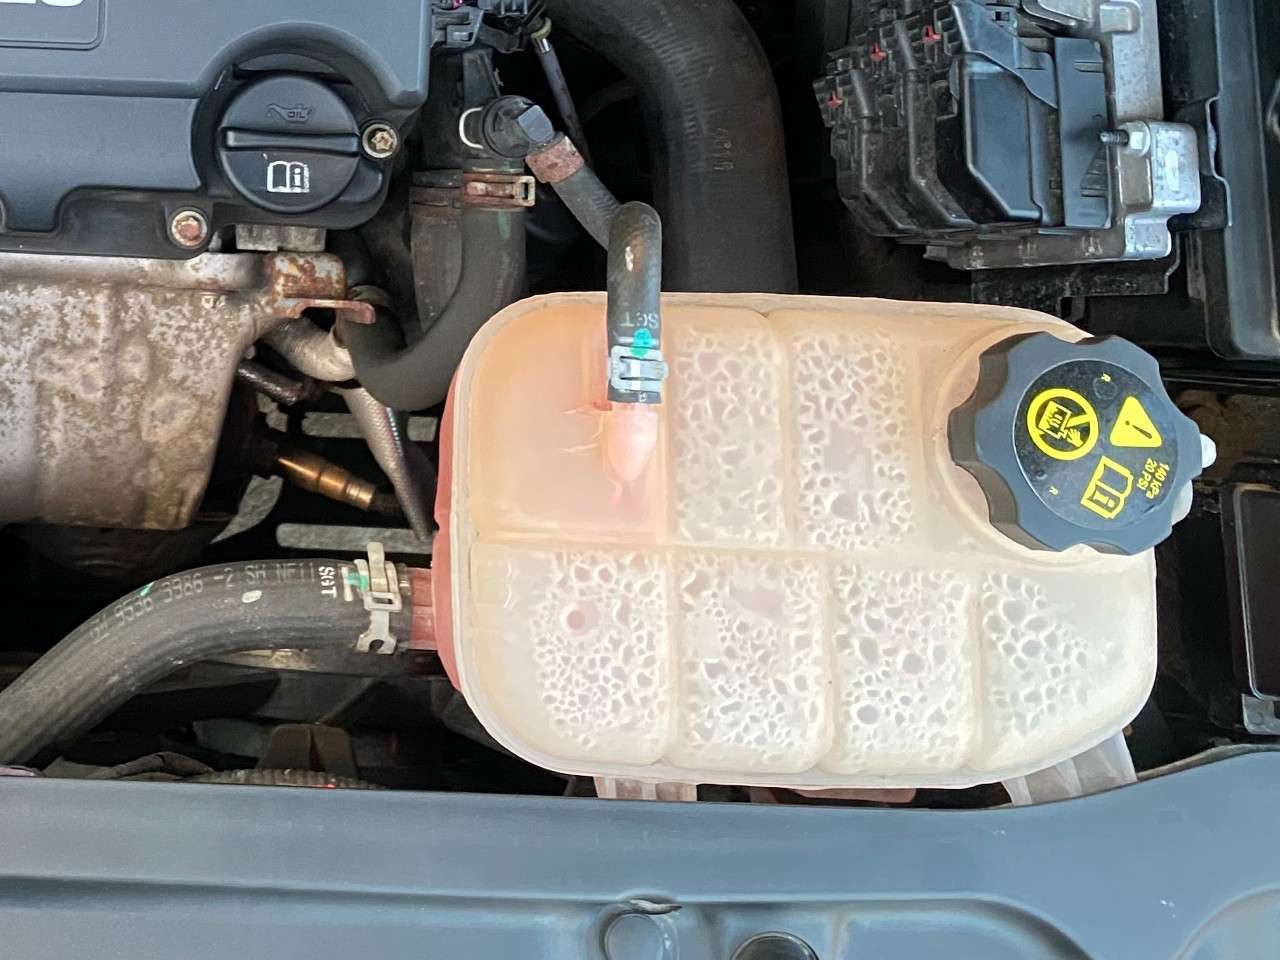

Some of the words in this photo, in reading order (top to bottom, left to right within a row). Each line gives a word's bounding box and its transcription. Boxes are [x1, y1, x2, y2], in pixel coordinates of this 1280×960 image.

[287, 111, 306, 119] OIL
[1144, 457, 1158, 473] 20
[1155, 462, 1170, 482] 140
[1136, 470, 1152, 491] PSI
[318, 566, 337, 599] SGT
